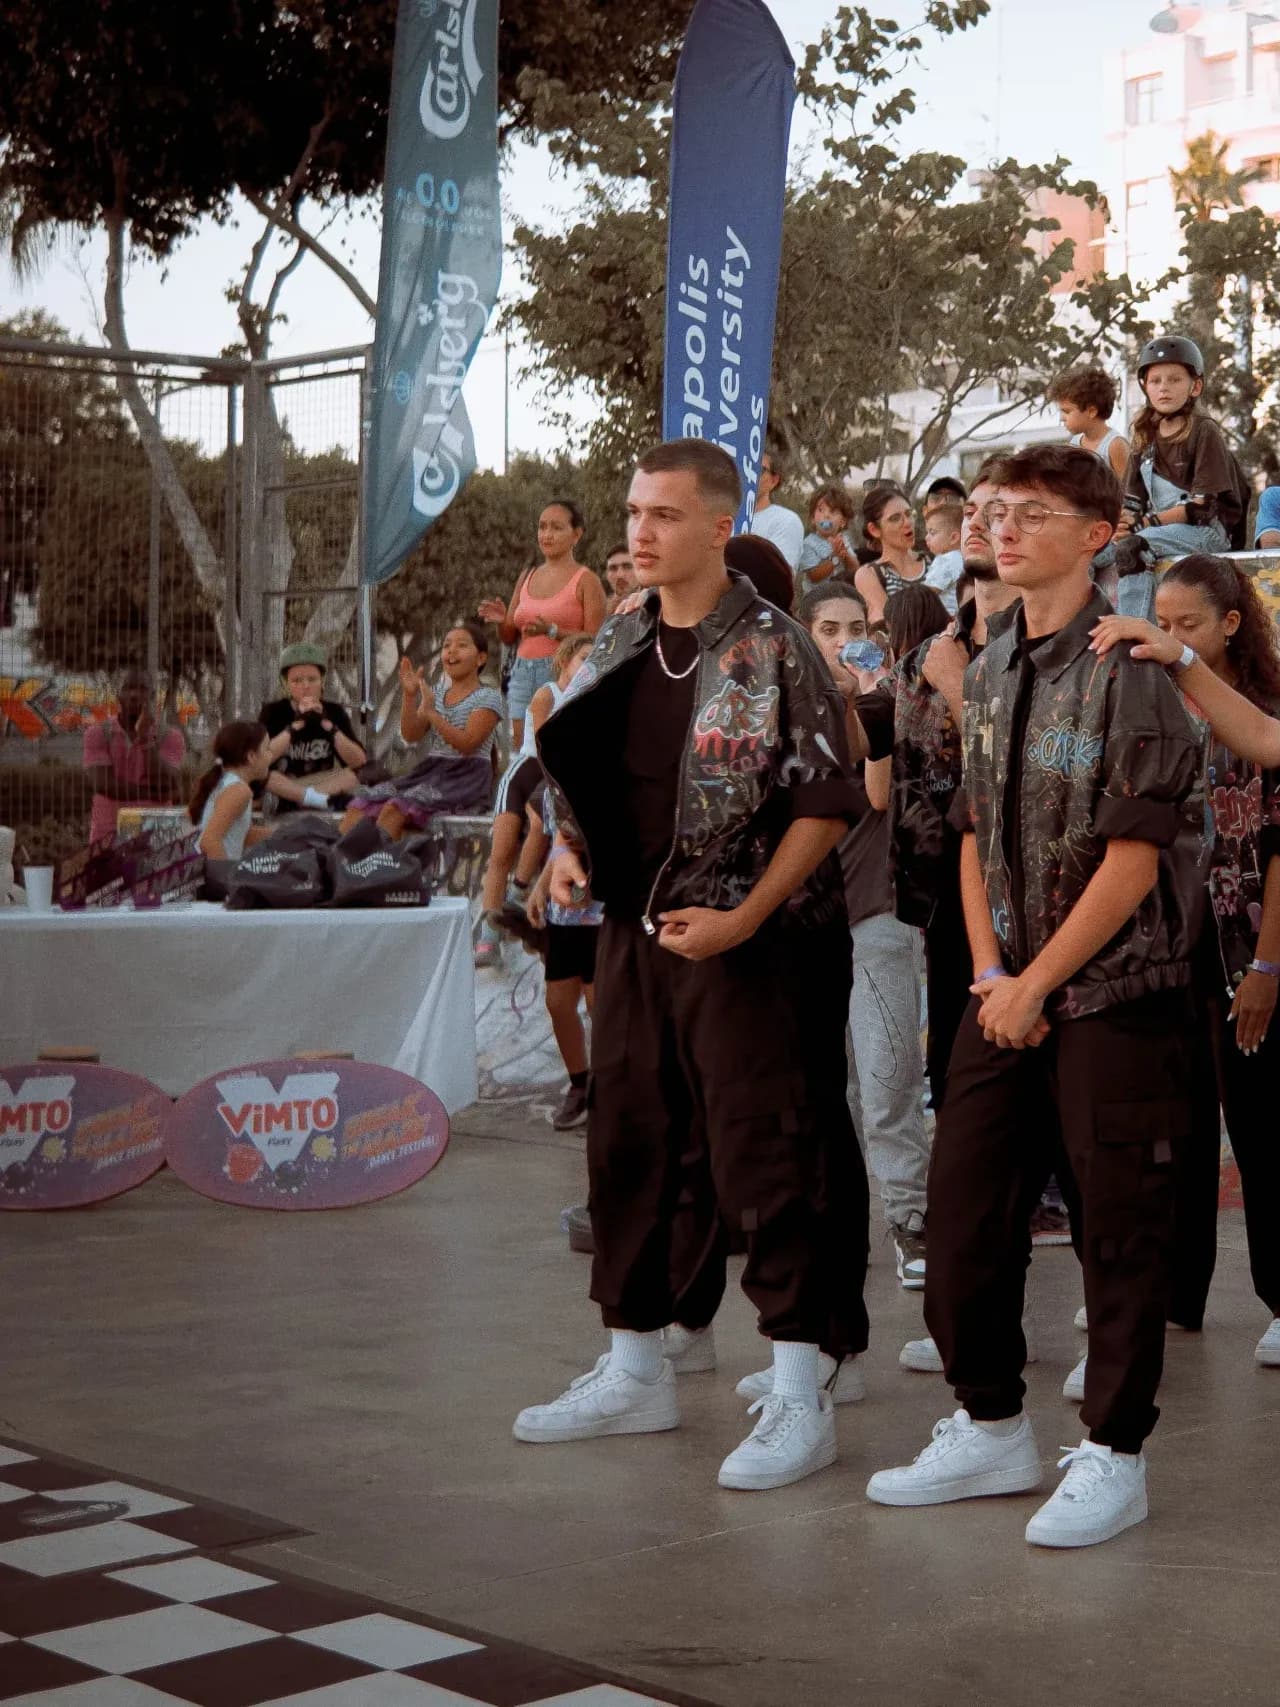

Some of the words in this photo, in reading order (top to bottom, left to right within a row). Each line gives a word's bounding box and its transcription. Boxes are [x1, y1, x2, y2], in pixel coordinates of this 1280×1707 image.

[419, 0, 480, 139] Carls
[678, 255, 710, 440] apolis
[712, 226, 751, 458] iversity
[0, 1098, 71, 1134] MTO
